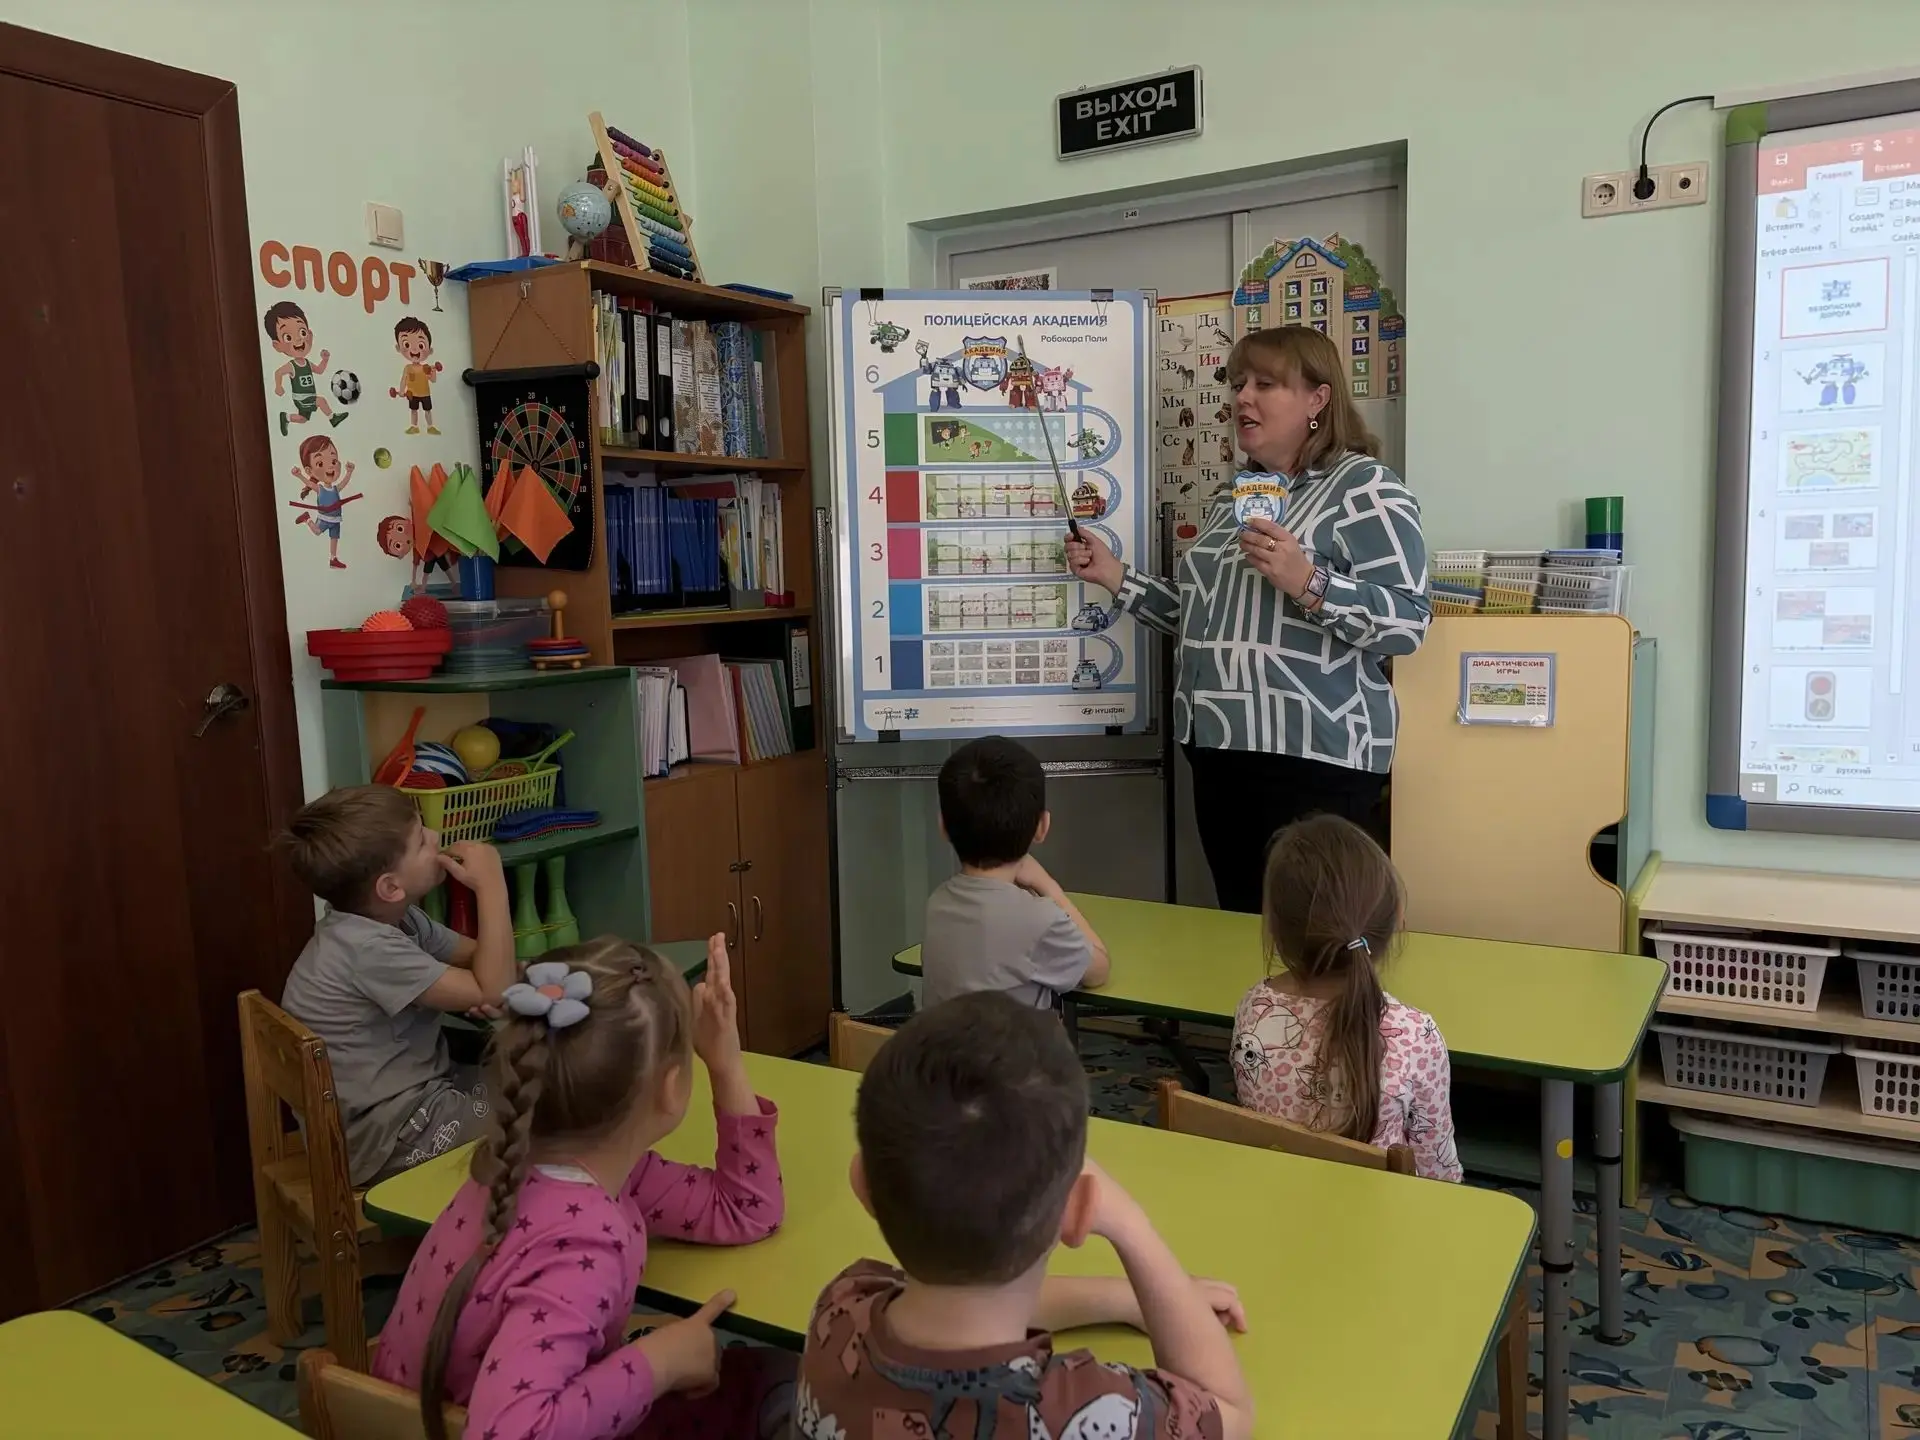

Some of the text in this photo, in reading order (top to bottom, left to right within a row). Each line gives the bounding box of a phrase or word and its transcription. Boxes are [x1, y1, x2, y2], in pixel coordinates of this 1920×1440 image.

[1077, 82, 1177, 120] ВЫХОД
[1097, 111, 1156, 140] EXIT
[1766, 223, 1803, 232] Вставить
[1289, 284, 1297, 294] Б
[1313, 283, 1323, 292] П
[1289, 307, 1298, 316] В
[1313, 303, 1324, 313] Ф
[924, 312, 1108, 328] ПОЛИЦЕЙСКАЯ АКАДЕМИЯ
[1249, 309, 1258, 322] Й
[1161, 320, 1175, 332] Гг
[1198, 315, 1219, 329] Дд
[1356, 321, 1365, 330] Х
[1041, 334, 1108, 344] Робокара Поли
[964, 346, 1006, 355] АКАДЕМИЯ
[1355, 342, 1366, 351] Ц
[1199, 353, 1220, 366] Ии
[1764, 352, 1769, 360] 2
[1161, 359, 1177, 371] Зз
[1356, 362, 1366, 372] Ч
[866, 364, 880, 384] 6
[300, 376, 312, 385] 29
[1354, 383, 1367, 393] Щ
[1162, 396, 1185, 408] Мм
[1200, 392, 1221, 404] Нн
[502, 406, 508, 414] 12
[867, 430, 880, 448] 5
[1163, 434, 1180, 446] Сс
[1200, 431, 1219, 443] Тт
[1761, 431, 1767, 439] 3
[1164, 472, 1182, 486] Цц
[1201, 469, 1219, 480] Чч
[1235, 483, 1282, 494] АКАДЕМИЯ
[869, 486, 883, 504] 4
[1759, 510, 1765, 518] 4
[870, 543, 883, 561] 3
[1756, 587, 1762, 596] 5
[872, 601, 885, 618] 2
[875, 655, 883, 673] 1
[1753, 664, 1760, 673] 6
[1808, 786, 1843, 795] Поиск
